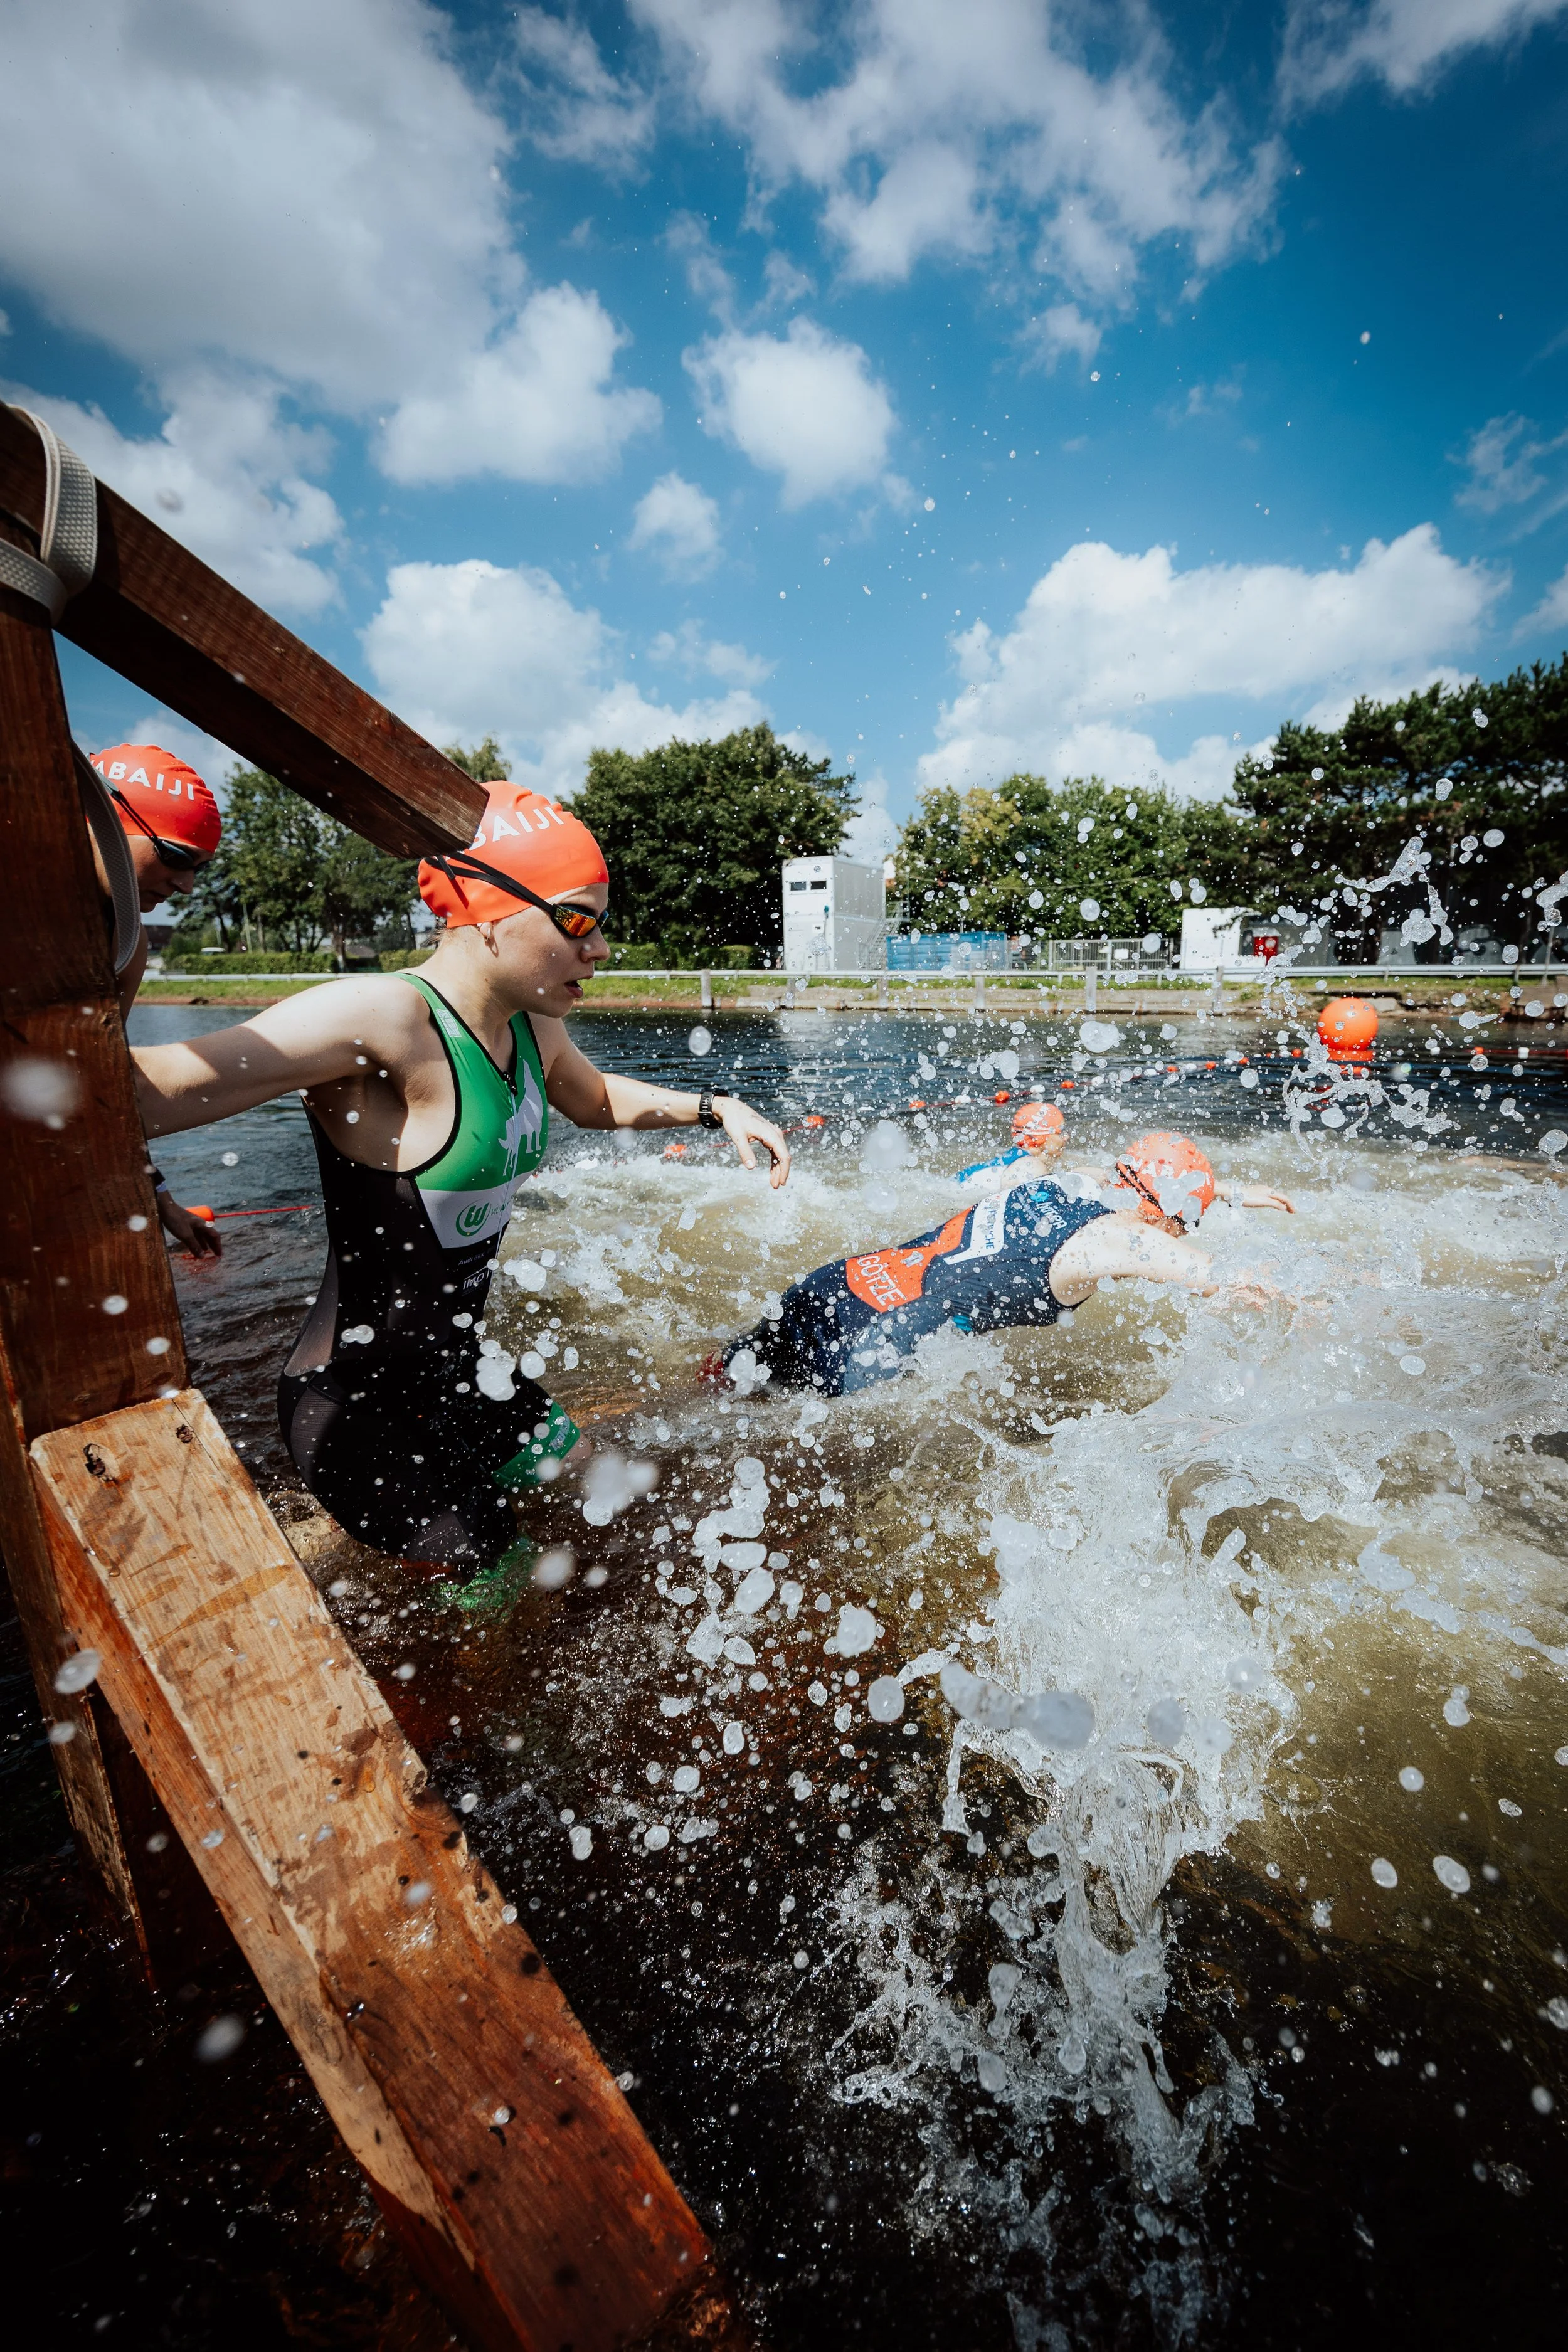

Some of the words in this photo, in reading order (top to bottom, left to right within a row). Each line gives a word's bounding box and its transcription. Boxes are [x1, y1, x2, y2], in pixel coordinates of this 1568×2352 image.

[90, 760, 194, 800] ABAIJI
[458, 1257, 473, 1266] Audi
[857, 1256, 908, 1306] GÖTZE
